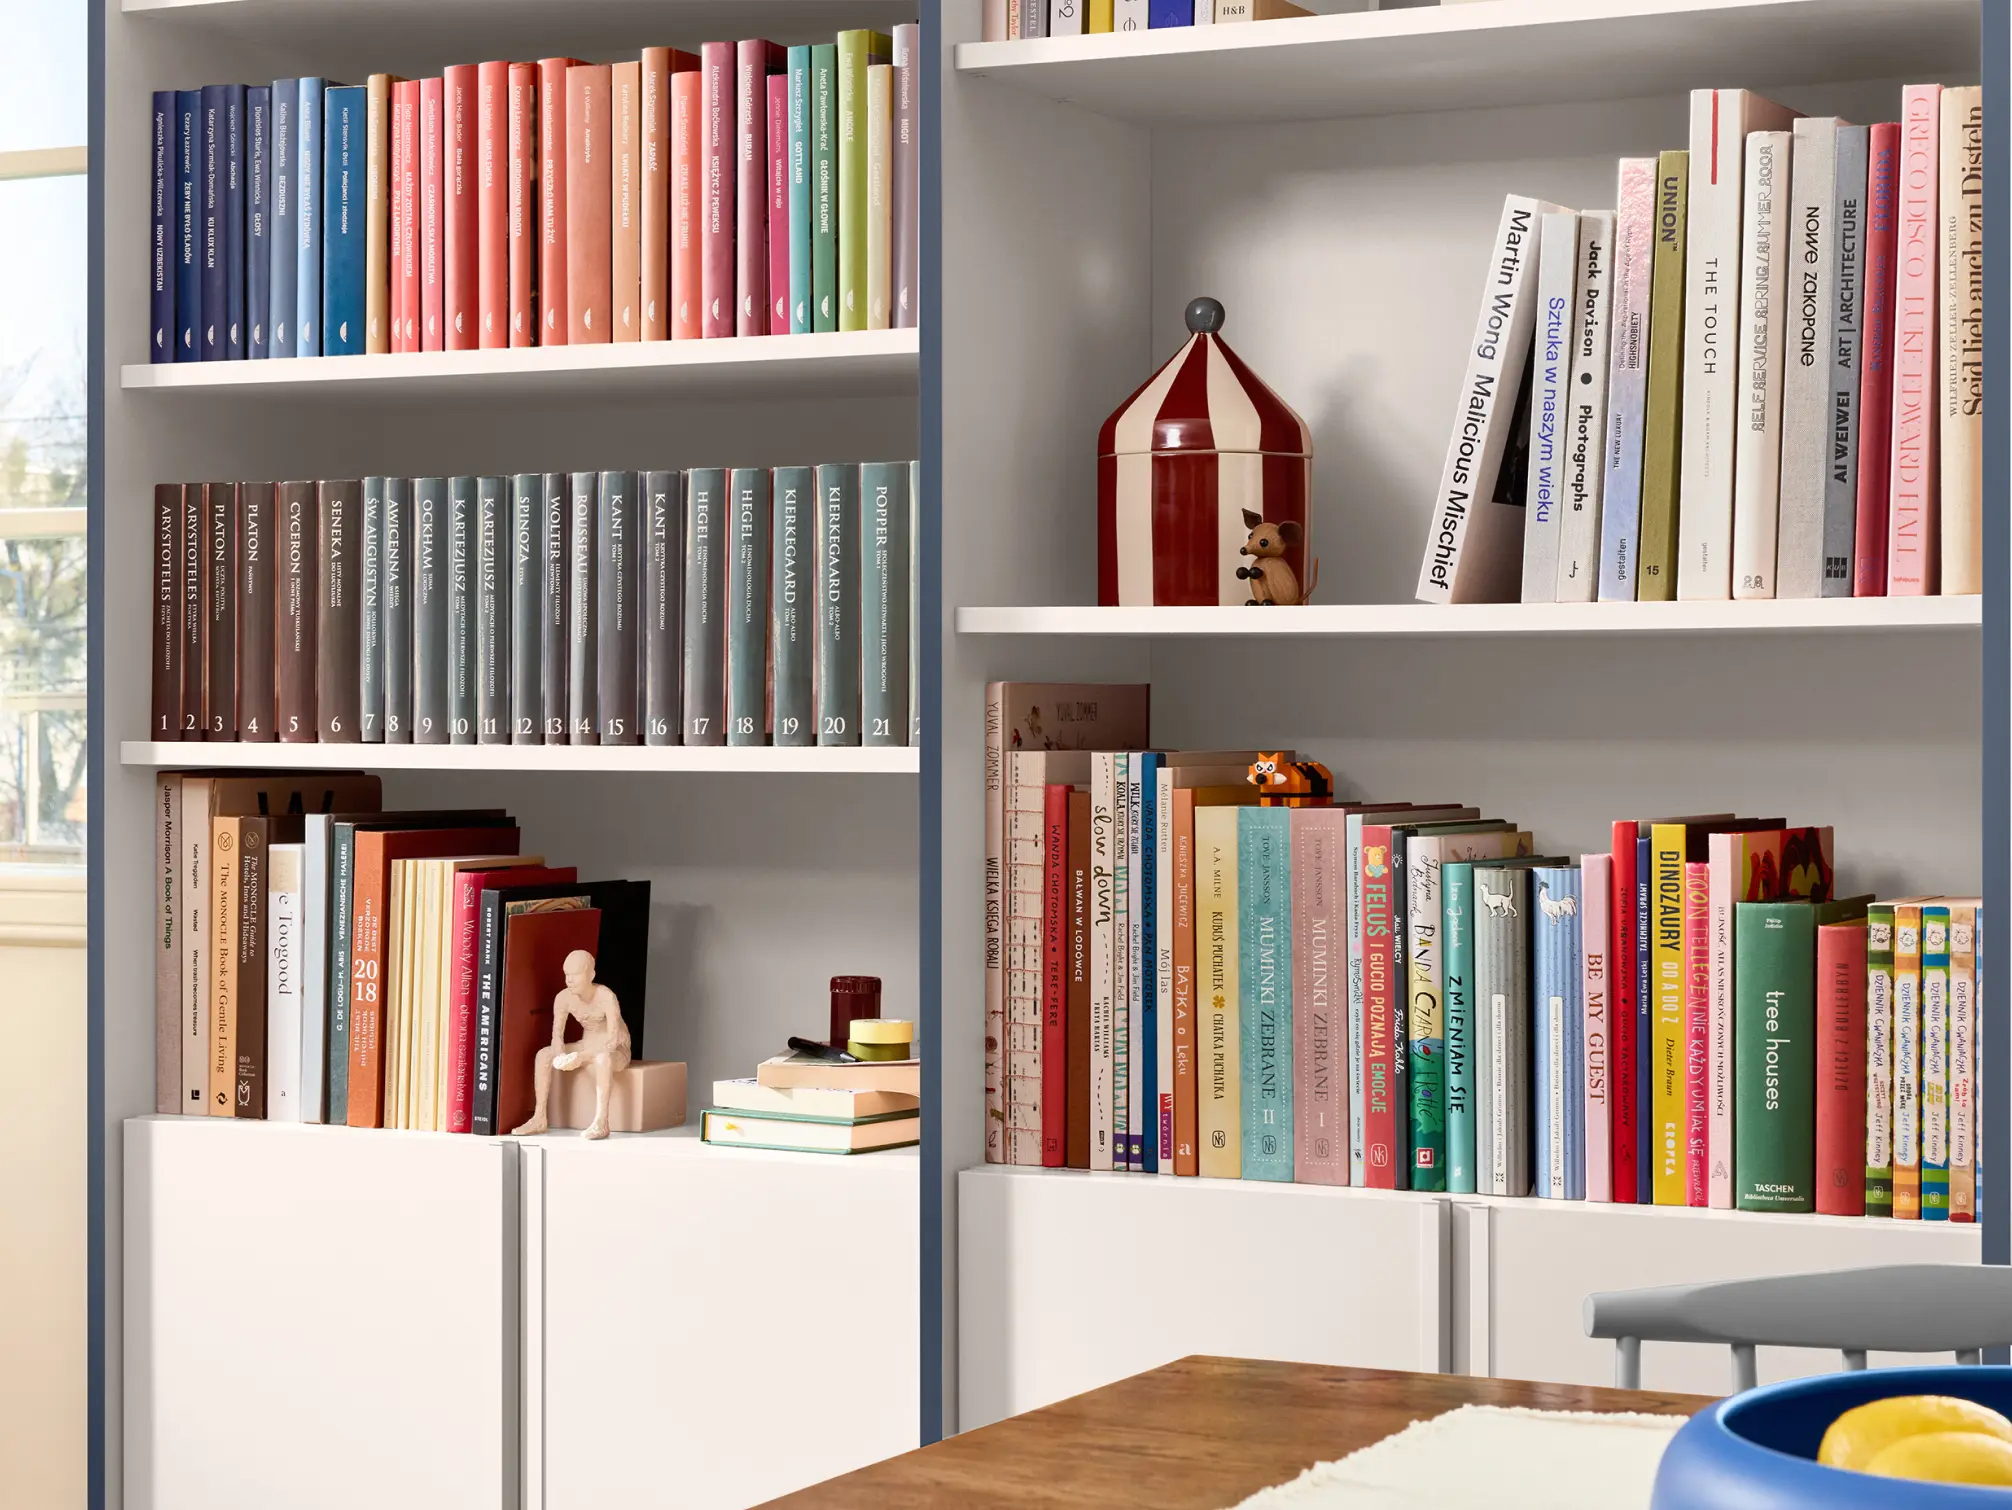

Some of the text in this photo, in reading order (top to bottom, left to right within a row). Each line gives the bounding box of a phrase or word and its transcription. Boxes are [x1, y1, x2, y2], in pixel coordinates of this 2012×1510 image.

[1223, 6, 1245, 15] H&B
[156, 113, 164, 145] Agnieszka
[183, 113, 191, 136] Cezary
[207, 109, 215, 142] Katarzyna
[901, 119, 909, 144] MIGOT
[156, 147, 164, 216] Pikulicka-Wilczewska
[184, 182, 192, 199] ŻEBY
[795, 142, 803, 183] GOTTLAND
[820, 160, 829, 193] GŁOŚNIK
[208, 217, 214, 227] KU
[820, 203, 829, 233] GŁOWIE
[184, 234, 192, 263] ŚLADÓW
[1838, 199, 1857, 368] ART ARCHITECTURE
[1628, 312, 1638, 369] HIGHSNOBIETY
[1703, 258, 1717, 375] THE TOUCH
[1896, 98, 1929, 563] GRECO DISCO LUKE EDWARD HALL
[1948, 216, 1957, 418] WILFRIED ZELLER-ZELLENBERG
[1428, 209, 1532, 590] Martin Wong Malicious Mischief
[1572, 241, 1601, 512] Jack Davison Photographs
[1535, 297, 1566, 523] Sztuka w naszym wieku
[1833, 391, 1850, 483] AI WEIWEI
[215, 505, 225, 561] PLATON
[248, 504, 258, 561] PLATON
[290, 502, 300, 573] CYCERON
[331, 500, 342, 558] SENEKA
[388, 500, 399, 582] AWICENNA
[423, 500, 433, 568] OCKHAM
[519, 496, 529, 563] SPINOZA
[550, 496, 560, 560] WOLTER
[577, 495, 587, 573] ROUSSEAU
[612, 495, 622, 539] KANT
[655, 493, 666, 538] KANT
[697, 492, 708, 542] HEGEL
[741, 490, 753, 540] HEGEL
[876, 486, 887, 546] POPPER
[161, 505, 172, 601] ARYSTOTELES
[187, 505, 197, 600] ARYSTOTELES
[366, 498, 380, 606] ŚW. AUGUSTYN
[453, 500, 466, 591] KARTEZJUSZ
[482, 498, 495, 591] KARTEZJUSZ
[784, 489, 796, 603] KIERKEGAARD
[829, 487, 840, 601] KIERKEGAARD
[1617, 539, 1627, 581] gestalten
[1646, 565, 1659, 575] 15
[451, 718, 468, 734] 10
[483, 718, 497, 734] 11
[516, 718, 532, 734] 12
[546, 718, 562, 734] 13
[575, 718, 590, 734] 14
[608, 719, 624, 736] 15
[651, 719, 667, 735] 16
[693, 718, 709, 735] 17
[737, 717, 754, 734] 18
[782, 717, 799, 735] 19
[825, 717, 846, 734] 20
[873, 719, 890, 736] 21
[986, 702, 999, 790] YUVAL ZOMMER
[163, 786, 172, 818] Jasper
[163, 821, 172, 864] Morrison
[1094, 806, 1112, 926] slow down
[164, 877, 173, 900] Book
[164, 905, 173, 914] of
[338, 879, 346, 940] VENEZIANISCHE
[985, 857, 1000, 933] WIELKA KSIĘGA
[1659, 851, 1681, 951] DINOZAURY
[163, 917, 173, 949] Things
[274, 912, 293, 995] Toogood
[1075, 930, 1084, 982] LODÓWCE
[217, 863, 230, 1073] The MONOCLE Book of Gentle Living
[354, 960, 378, 979] 20
[355, 982, 377, 1002] 18
[1159, 949, 1170, 993] Mój las
[1176, 966, 1189, 1075] BAJKA Lęku
[1212, 911, 1226, 1099] KUBUŚ PUCHATEK CHATKA PUCHATKA
[1260, 916, 1275, 1099] MUMINKI ZEBRANE
[1312, 918, 1329, 1102] MUMINKI ZEBRANE
[1366, 884, 1388, 1113] FELUŚ GUCIO POZNAJĄ EMOCJE
[478, 974, 491, 1091] THE AMERICANS
[1393, 1009, 1404, 1074] Frida Kahlo
[1587, 953, 1605, 1104] BE MY GUEST
[1766, 991, 1790, 1110] tree houses
[1665, 1038, 1675, 1096] Dieter Braun
[1954, 1112, 1965, 1163] Jeff Kinney
[1755, 1184, 1793, 1192] TASCHEN
